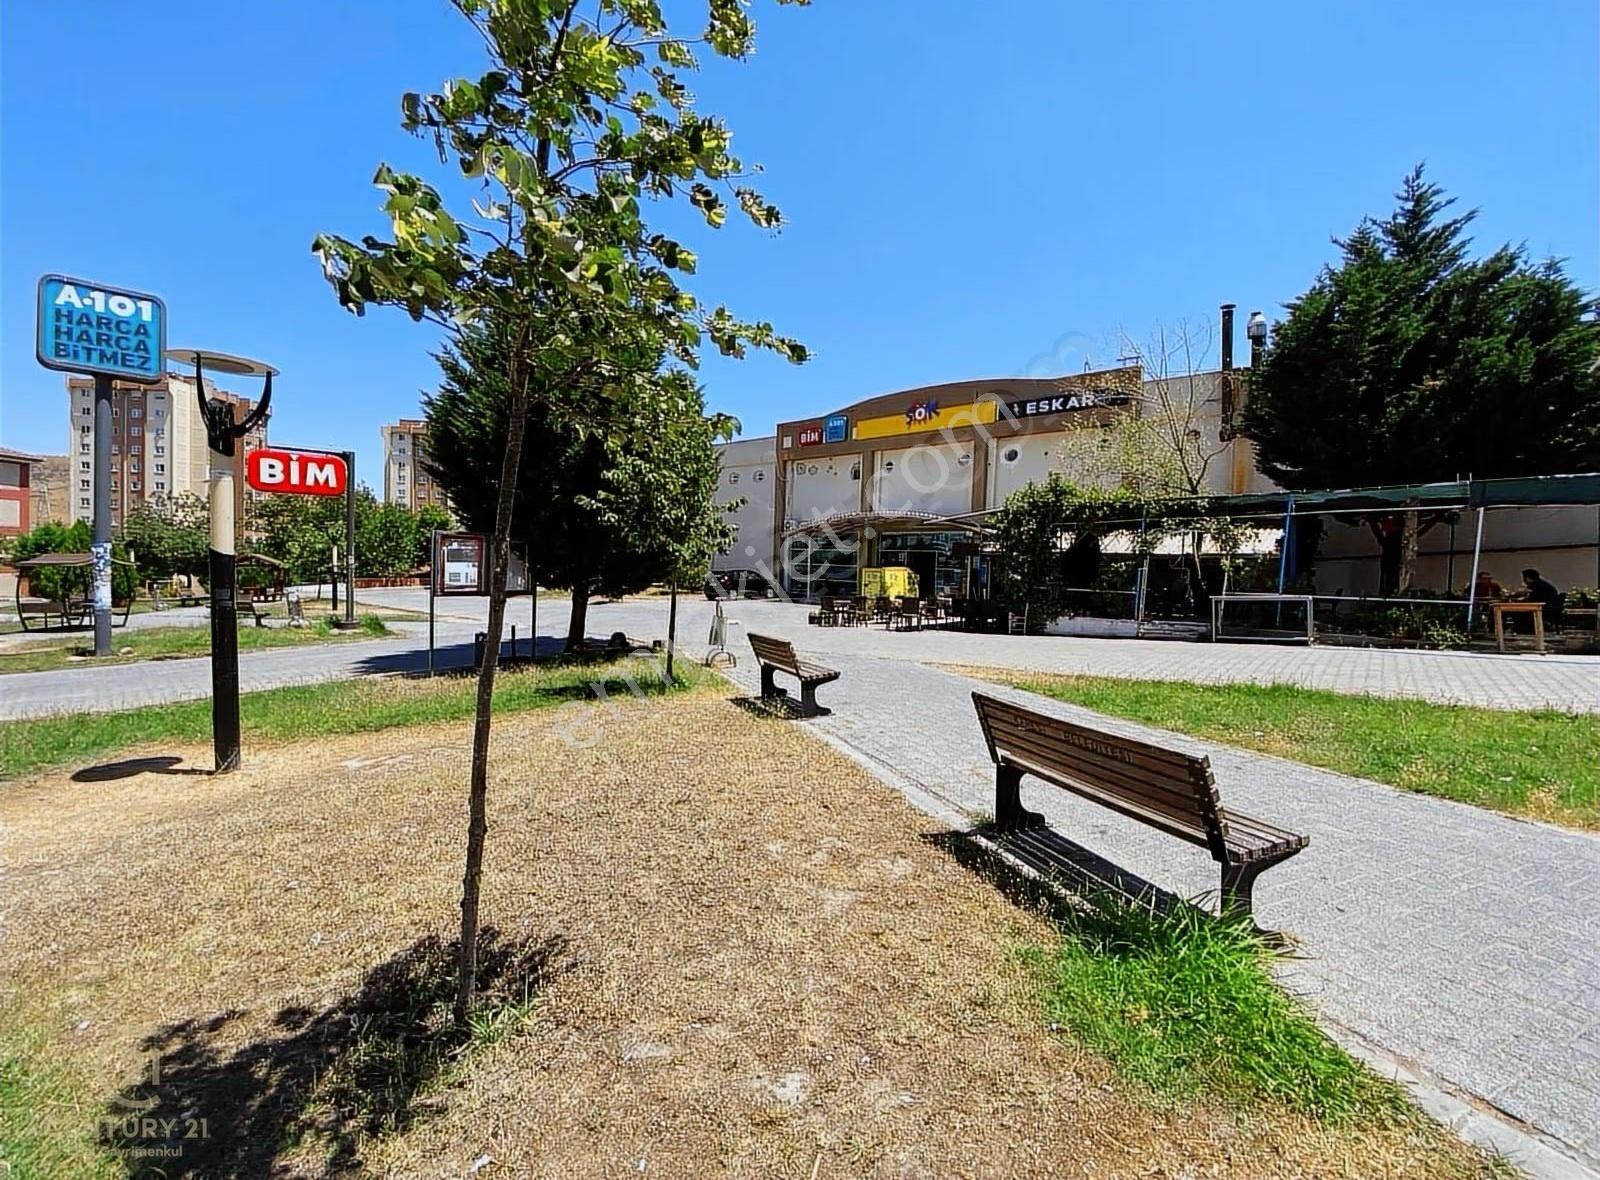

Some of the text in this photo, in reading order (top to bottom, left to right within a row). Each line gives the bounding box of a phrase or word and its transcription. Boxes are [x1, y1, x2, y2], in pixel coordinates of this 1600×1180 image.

[55, 308, 151, 338] HARCA
[55, 324, 151, 354] HARCA
[260, 454, 337, 488] BİM
